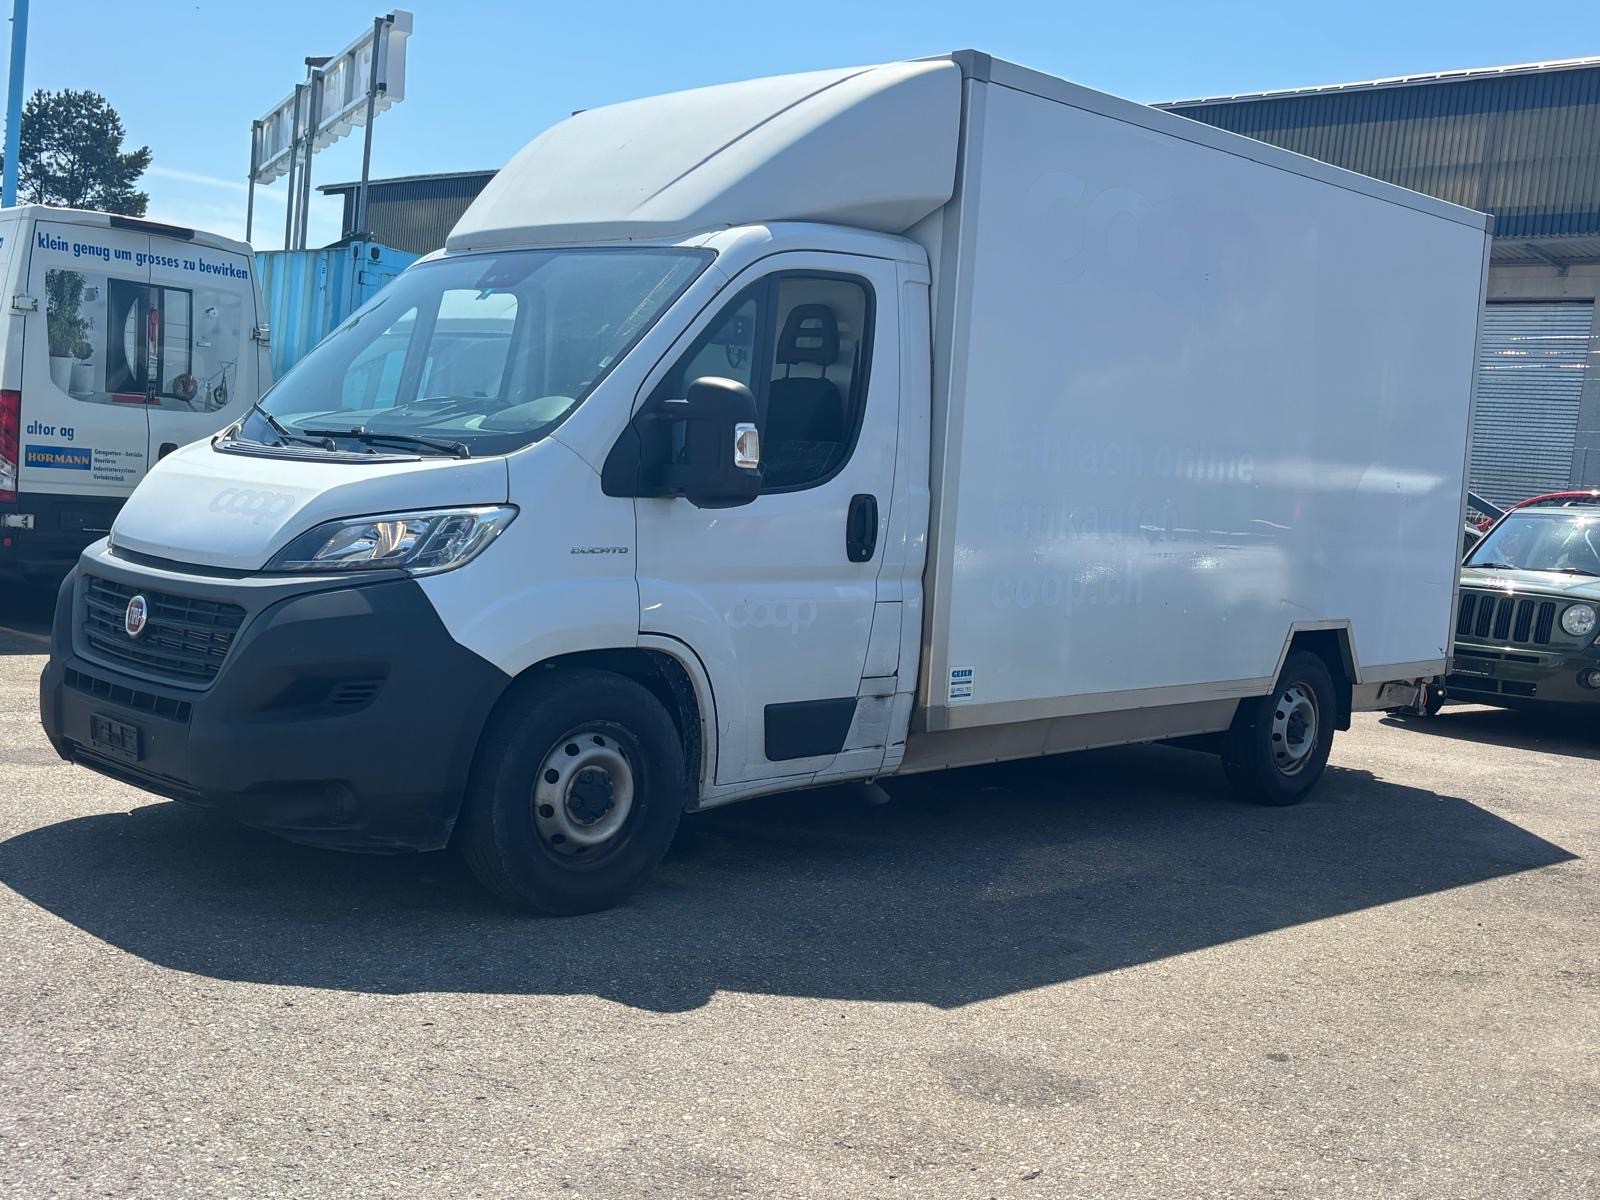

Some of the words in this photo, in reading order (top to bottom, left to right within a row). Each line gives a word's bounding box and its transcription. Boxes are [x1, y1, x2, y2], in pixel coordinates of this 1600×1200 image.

[38, 232, 69, 252] klein
[73, 242, 110, 261] genug
[114, 248, 132, 261] um
[136, 252, 179, 268] grosses
[183, 259, 196, 271] zu
[199, 258, 248, 280] bewirken
[27, 420, 56, 436] altor
[60, 427, 74, 441] ag
[208, 487, 295, 518] coop
[571, 546, 629, 554] DUCATO
